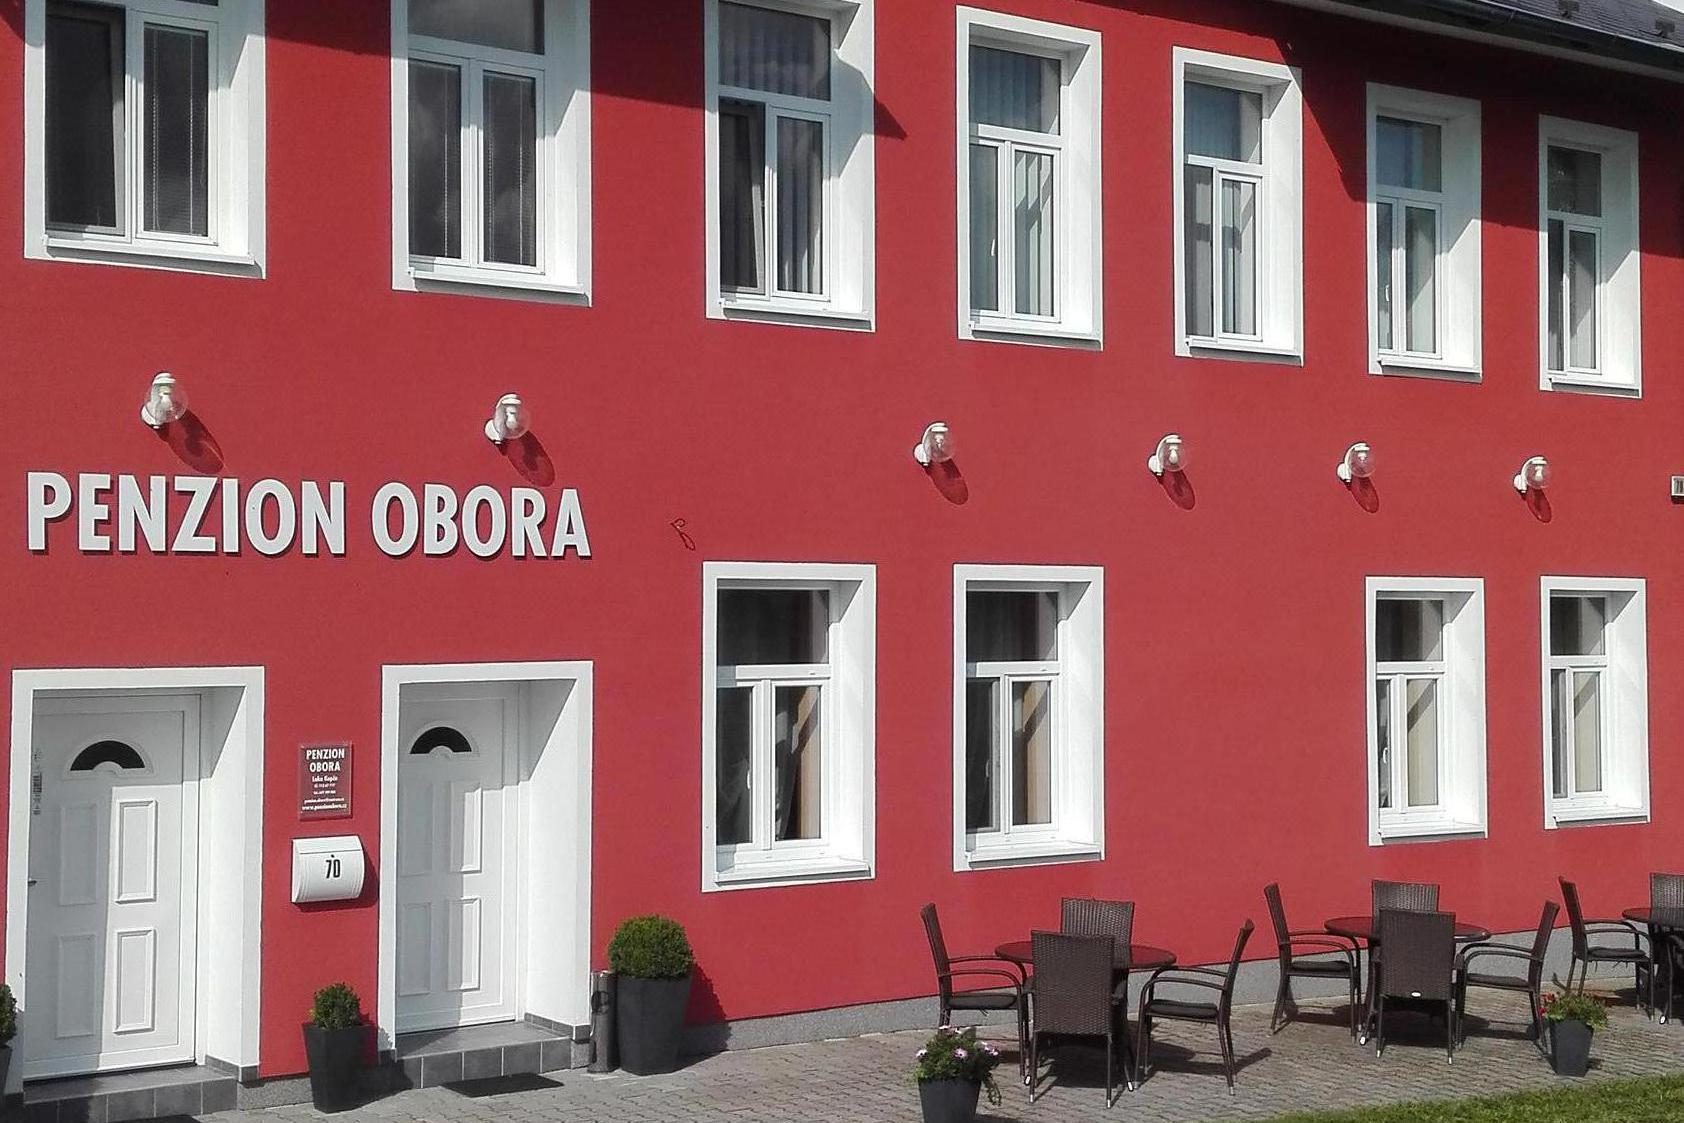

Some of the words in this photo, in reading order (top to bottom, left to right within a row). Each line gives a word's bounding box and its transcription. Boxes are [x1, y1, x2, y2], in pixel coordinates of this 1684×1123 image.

[27, 471, 345, 555] PENZION
[371, 482, 592, 557] OBORA
[306, 748, 345, 760] PENZION
[309, 761, 341, 773] OBORA
[325, 859, 341, 879] 70
